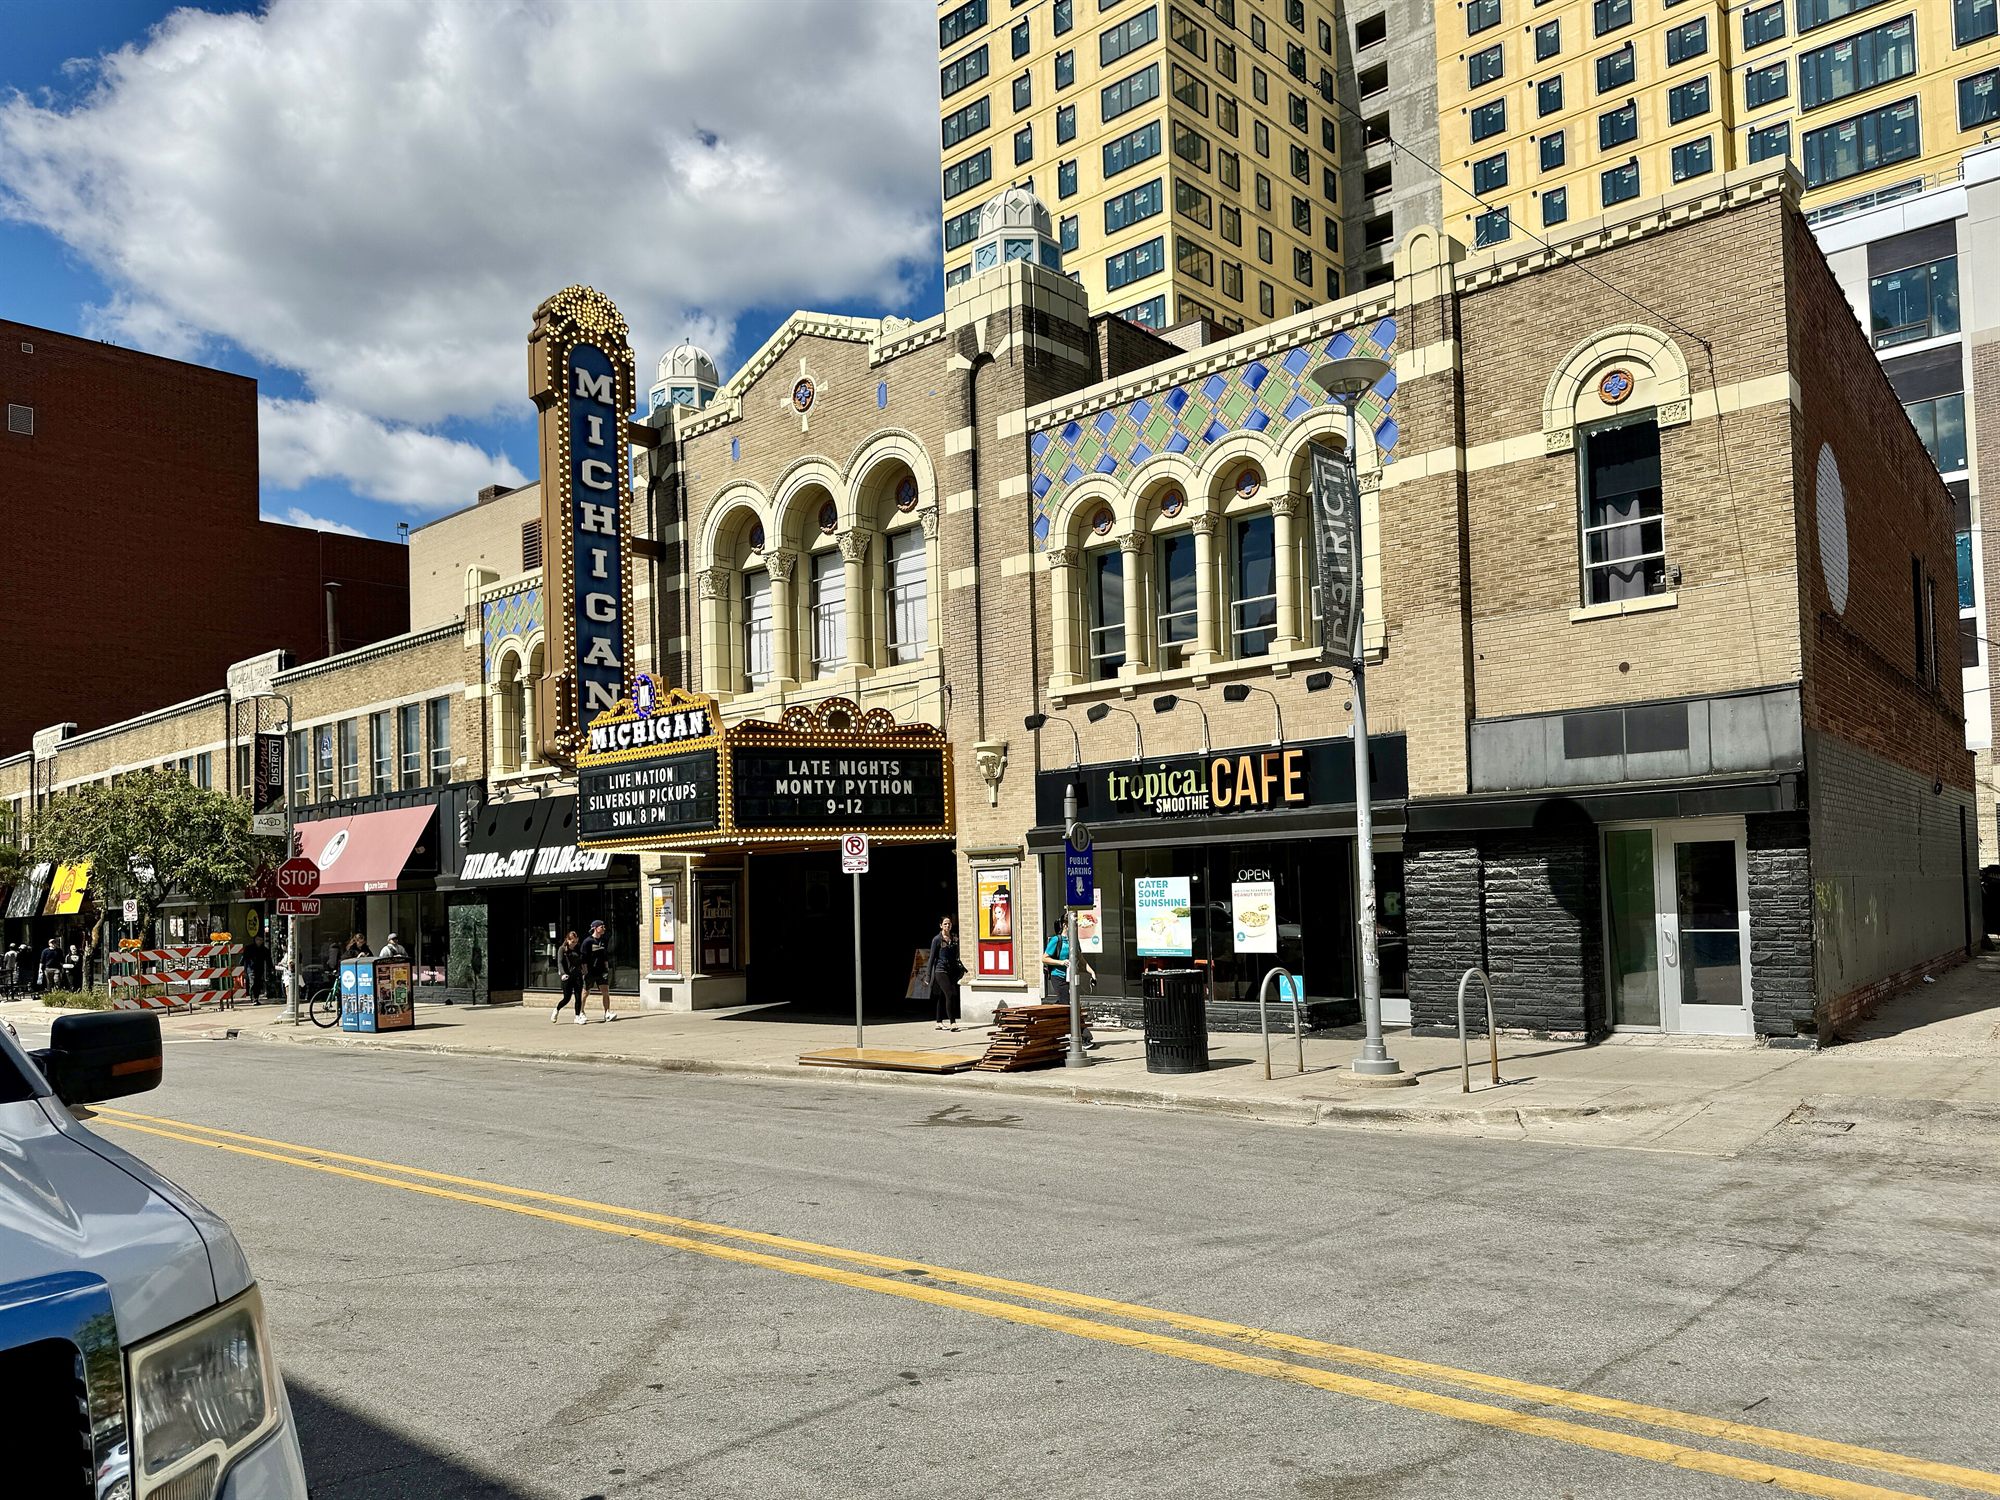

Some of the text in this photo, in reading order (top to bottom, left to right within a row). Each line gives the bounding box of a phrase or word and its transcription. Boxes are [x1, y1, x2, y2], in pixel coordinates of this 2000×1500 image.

[574, 366, 621, 711] MICHIGAN
[591, 710, 705, 751] MICHIGAN
[271, 742, 279, 783] DISTRICT
[788, 760, 900, 776] LATE NIGHTS
[609, 767, 673, 790] LIVE NATION
[1107, 749, 1305, 808] tropical CAFE
[776, 780, 913, 795] MONTY PYTHON
[589, 783, 697, 811] SILVERSUN PICKUPS
[1156, 795, 1209, 813] SMOOTHIE
[826, 799, 863, 814] 9-12
[612, 807, 666, 827] SUN. 8 PM
[1069, 857, 1089, 865] PUBLIC
[281, 870, 318, 886] STOP
[1067, 867, 1092, 876] PARKING
[1238, 868, 1271, 881] OPEN
[1138, 880, 1169, 889] CATER
[1138, 889, 1165, 898] SOME
[280, 902, 318, 912] ALL WAY
[1138, 898, 1187, 907] SUNSHINE
